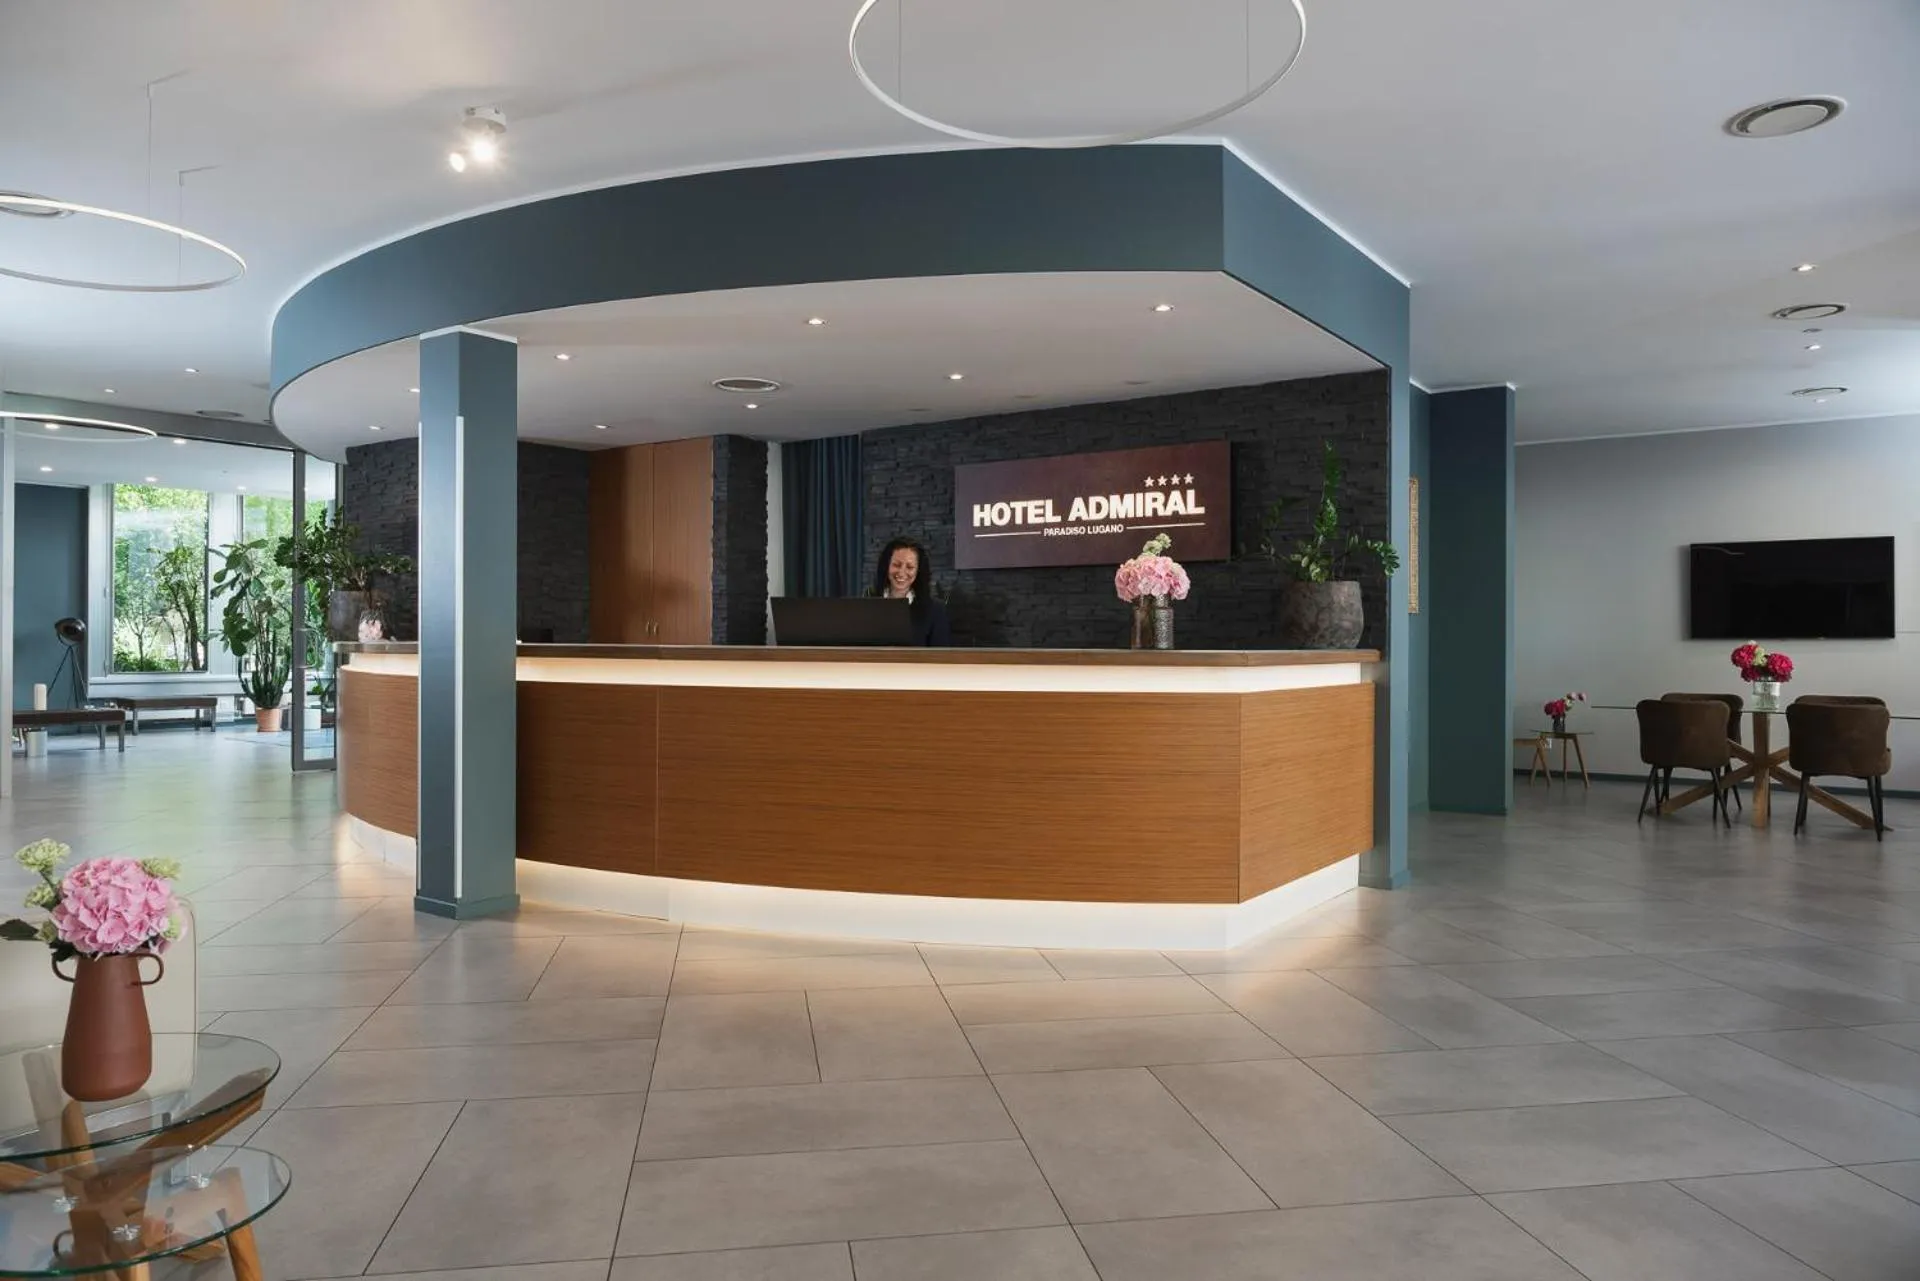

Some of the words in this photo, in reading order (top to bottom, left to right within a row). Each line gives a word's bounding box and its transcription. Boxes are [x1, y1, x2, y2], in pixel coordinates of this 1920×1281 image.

[972, 499, 1061, 527] HOTEL
[1068, 489, 1205, 521] ADMIRAL
[1043, 526, 1086, 537] PARADISO
[1087, 524, 1124, 534] LUGANO
